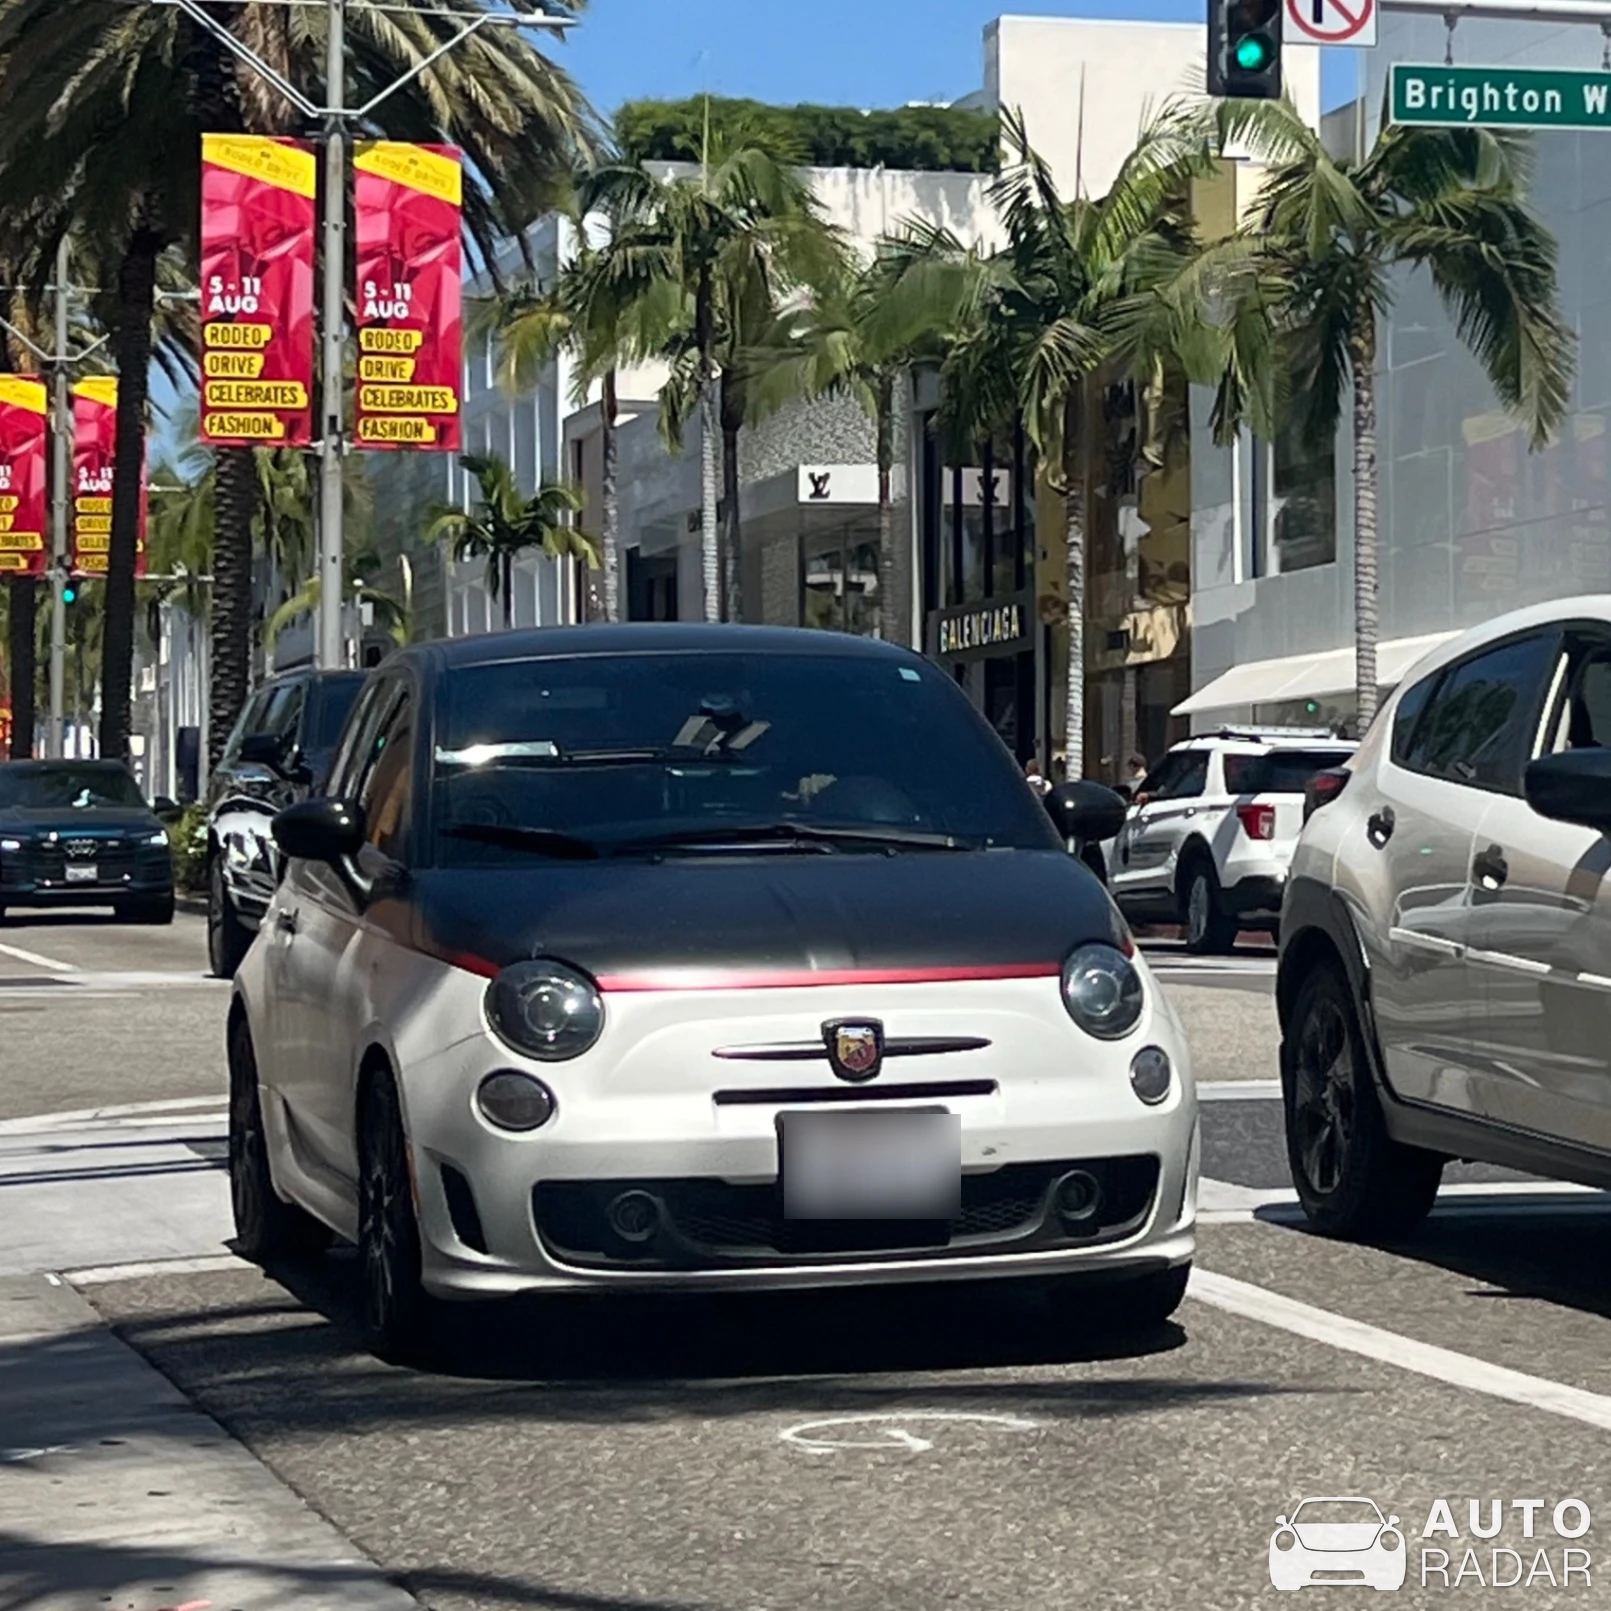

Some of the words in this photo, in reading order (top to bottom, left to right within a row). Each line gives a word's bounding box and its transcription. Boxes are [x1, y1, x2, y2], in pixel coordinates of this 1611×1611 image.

[1405, 78, 1562, 121] Brighton
[1582, 84, 1611, 114] W
[242, 276, 261, 296] 11
[394, 283, 412, 302] 11
[208, 295, 258, 314] AUG
[363, 300, 409, 319] AUG
[210, 326, 262, 345] RODEO
[365, 331, 413, 350] RODEO
[209, 355, 256, 375] DRIVE
[364, 359, 407, 379] DRIVE
[208, 384, 298, 405] CELEBRATES
[363, 388, 448, 410] CELEBRATES
[208, 415, 273, 435] FASHION
[362, 419, 424, 439] FASHION
[78, 479, 112, 492] AUG
[940, 603, 1021, 654] BALENCIAGA
